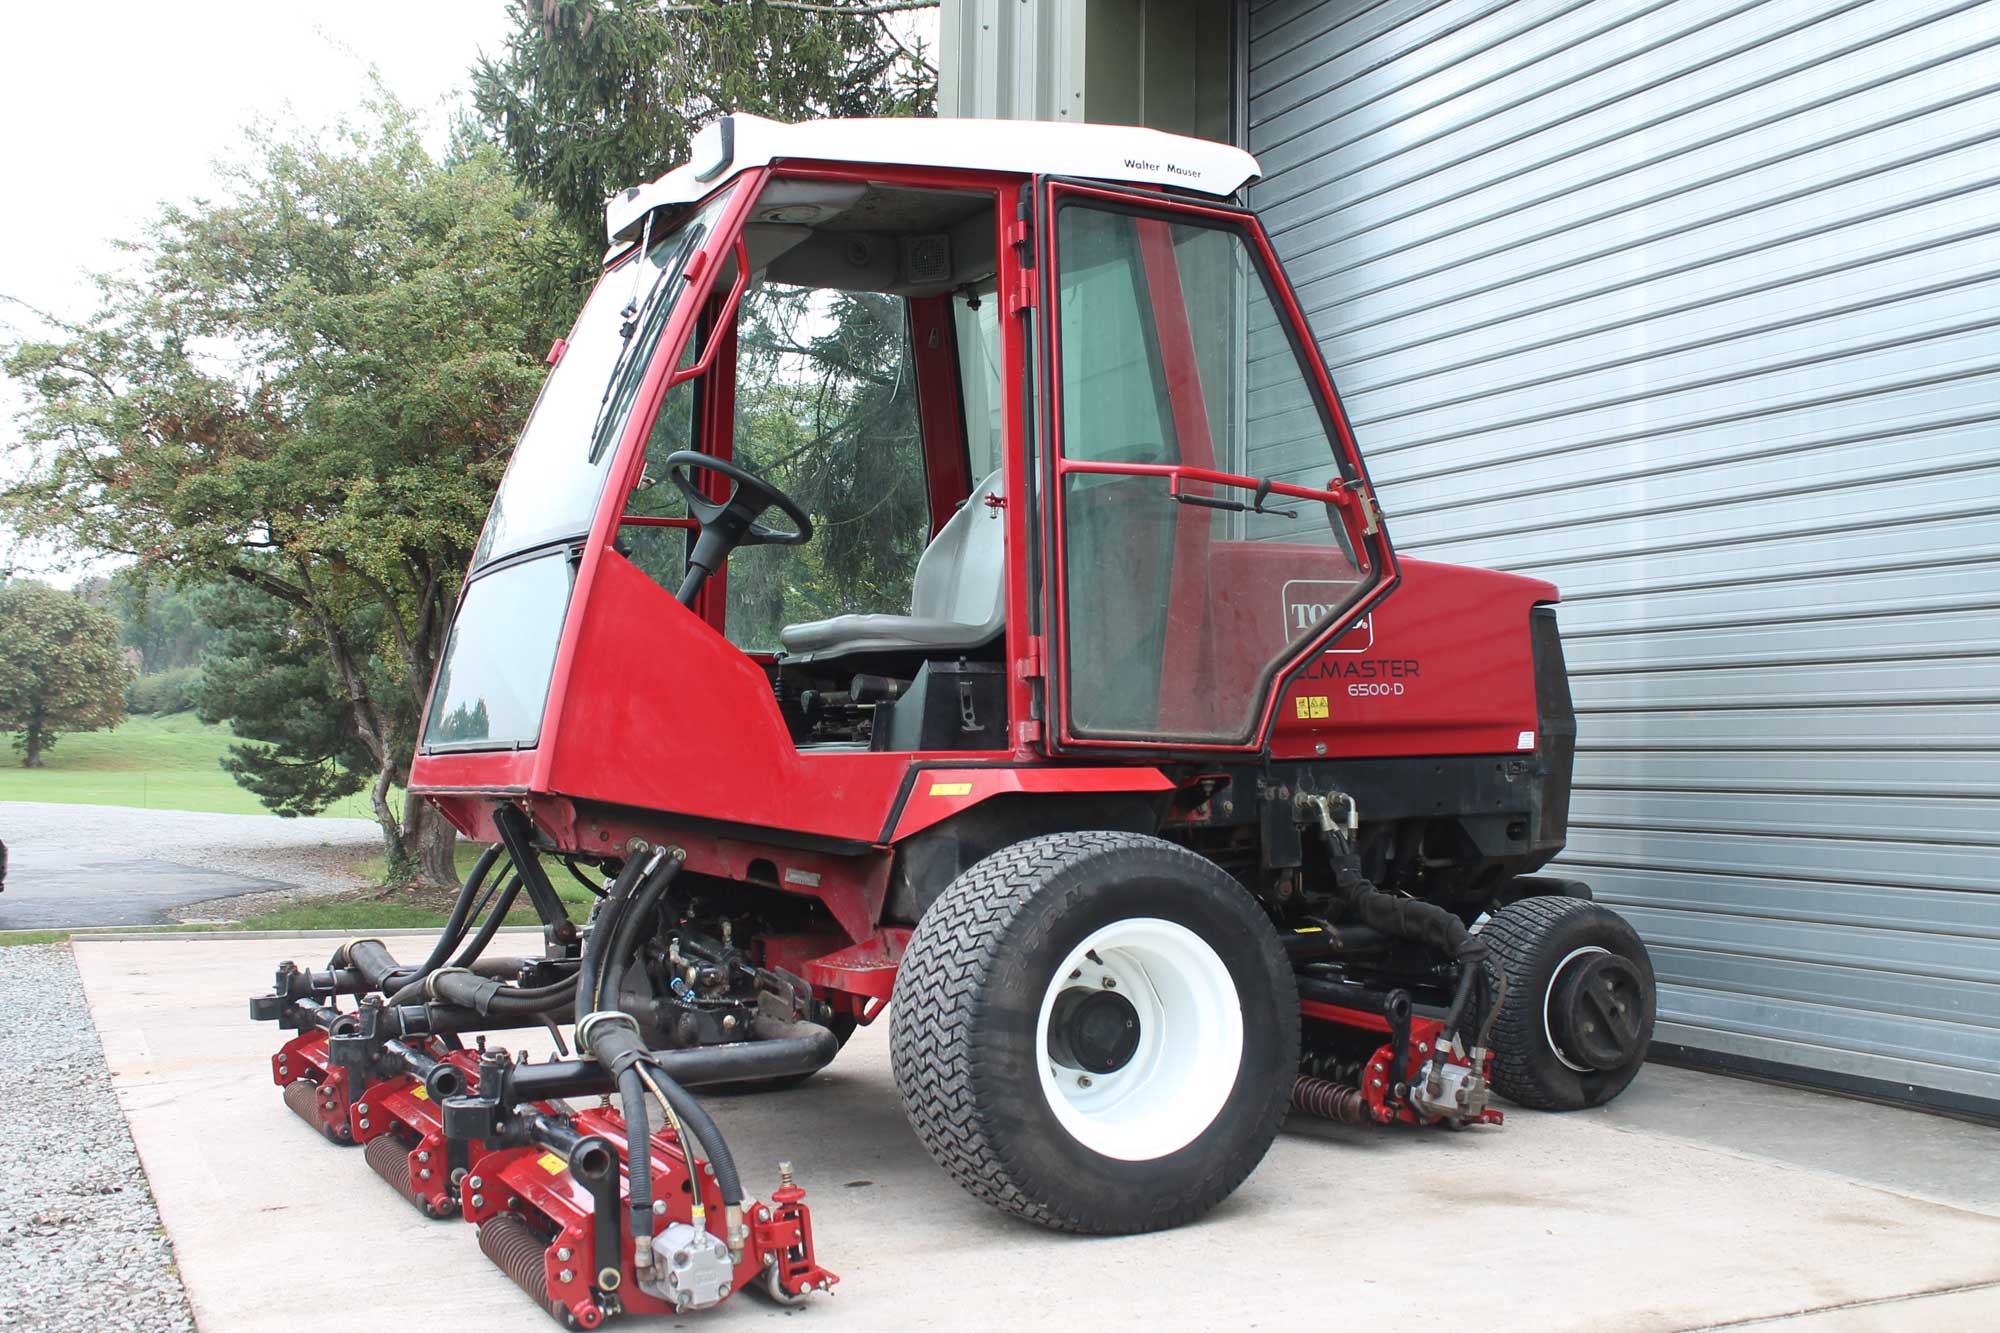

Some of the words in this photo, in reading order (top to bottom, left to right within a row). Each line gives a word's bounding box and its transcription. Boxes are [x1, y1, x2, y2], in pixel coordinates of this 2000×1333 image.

[1124, 158, 1160, 171] Walter
[1167, 164, 1202, 178] Mauser
[1291, 604, 1364, 629] TO
